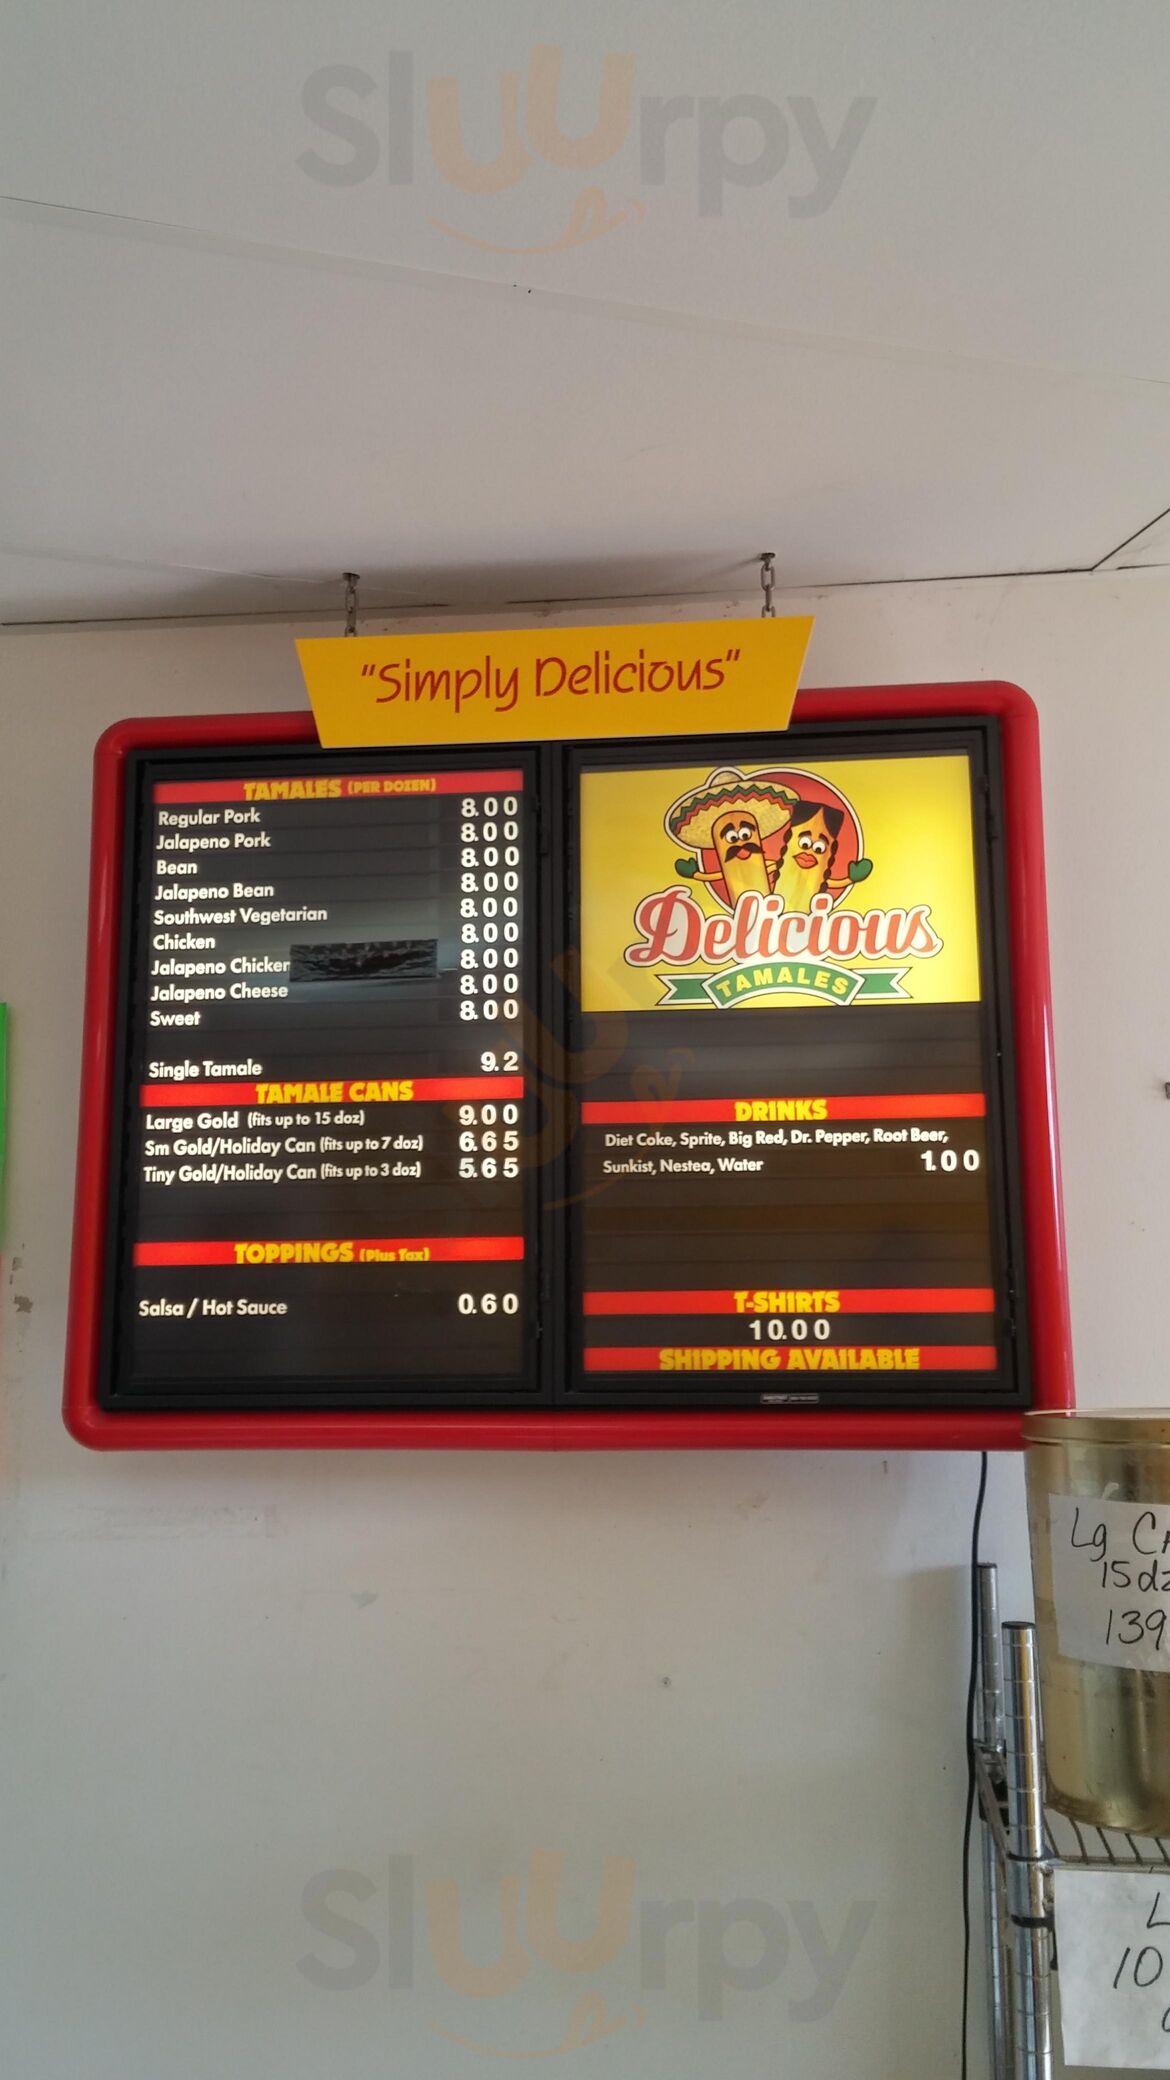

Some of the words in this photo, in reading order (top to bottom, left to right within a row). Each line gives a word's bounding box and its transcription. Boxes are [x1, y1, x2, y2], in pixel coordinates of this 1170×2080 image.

[361, 655, 519, 713] "Simply
[535, 648, 741, 696] Delicious"
[243, 780, 341, 801] TAMALES
[348, 780, 380, 794] (PER
[384, 778, 436, 793] DOZEN)
[159, 809, 220, 828] Regular
[225, 807, 260, 823] Pork
[157, 834, 229, 852] Jalapeno
[235, 832, 270, 847] Pork
[157, 860, 197, 874] Bean
[155, 884, 229, 902] Jalapeno
[234, 883, 273, 897] Bean
[154, 908, 236, 924] Southwest
[240, 907, 327, 925] Vegetarian
[624, 885, 944, 967] Delicious
[154, 933, 215, 950] Chicken
[151, 959, 226, 977] Jalapeno
[716, 966, 849, 997] TAMALES
[151, 984, 226, 1003] Jalapeno
[230, 982, 288, 998] Cheese
[150, 1011, 200, 1026] Sweet
[149, 1060, 199, 1080] Single
[203, 1059, 262, 1076] Tamale
[256, 1081, 344, 1104] TAMALE
[349, 1080, 413, 1102] CANS
[147, 1115, 193, 1132] Large
[197, 1111, 238, 1129] Gold
[248, 1112, 272, 1128] (fits
[275, 1116, 293, 1128] up
[296, 1114, 310, 1125] to
[315, 1112, 330, 1124] 15
[334, 1110, 364, 1125] doz)
[735, 1100, 827, 1121] DRINKS
[145, 1141, 169, 1155] Sm
[173, 1137, 281, 1157] Gold/Holiday
[285, 1137, 315, 1152] Can
[320, 1137, 342, 1152] (fits
[346, 1141, 361, 1154] up
[363, 1138, 379, 1151] to
[382, 1137, 391, 1149] 7
[394, 1135, 423, 1151] doz)
[606, 1134, 633, 1146] Diet
[637, 1132, 676, 1147] Coke,
[681, 1132, 725, 1148] Sprite,
[729, 1131, 752, 1148] Big
[756, 1129, 788, 1145] Red,
[791, 1130, 812, 1143] Dr.
[816, 1129, 870, 1146] Pepper,
[874, 1128, 908, 1142] Root
[911, 1128, 948, 1143] Beer,
[144, 1166, 175, 1185] Tiny
[179, 1163, 283, 1183] Gold/Holiday
[287, 1164, 316, 1179] Can
[321, 1164, 343, 1179] (fits
[346, 1168, 362, 1180] up
[365, 1166, 378, 1176] to
[381, 1163, 389, 1176] 3
[393, 1162, 421, 1177] doz)
[604, 1159, 656, 1175] Sunkist,
[661, 1160, 714, 1174] Nestea,
[718, 1158, 763, 1171] Water
[234, 1241, 353, 1264] TOPPINGS
[359, 1248, 394, 1262] (Plus
[400, 1247, 430, 1262] Tax)
[140, 1299, 183, 1316] Salsa
[187, 1298, 198, 1318] /
[203, 1300, 233, 1315] Hot
[237, 1299, 287, 1314] Sauce
[734, 1291, 840, 1313] T-SHIRTS
[659, 1349, 781, 1370] SHIPPING
[787, 1348, 920, 1369] AVAILABLE
[1071, 1507, 1106, 1562] Lg
